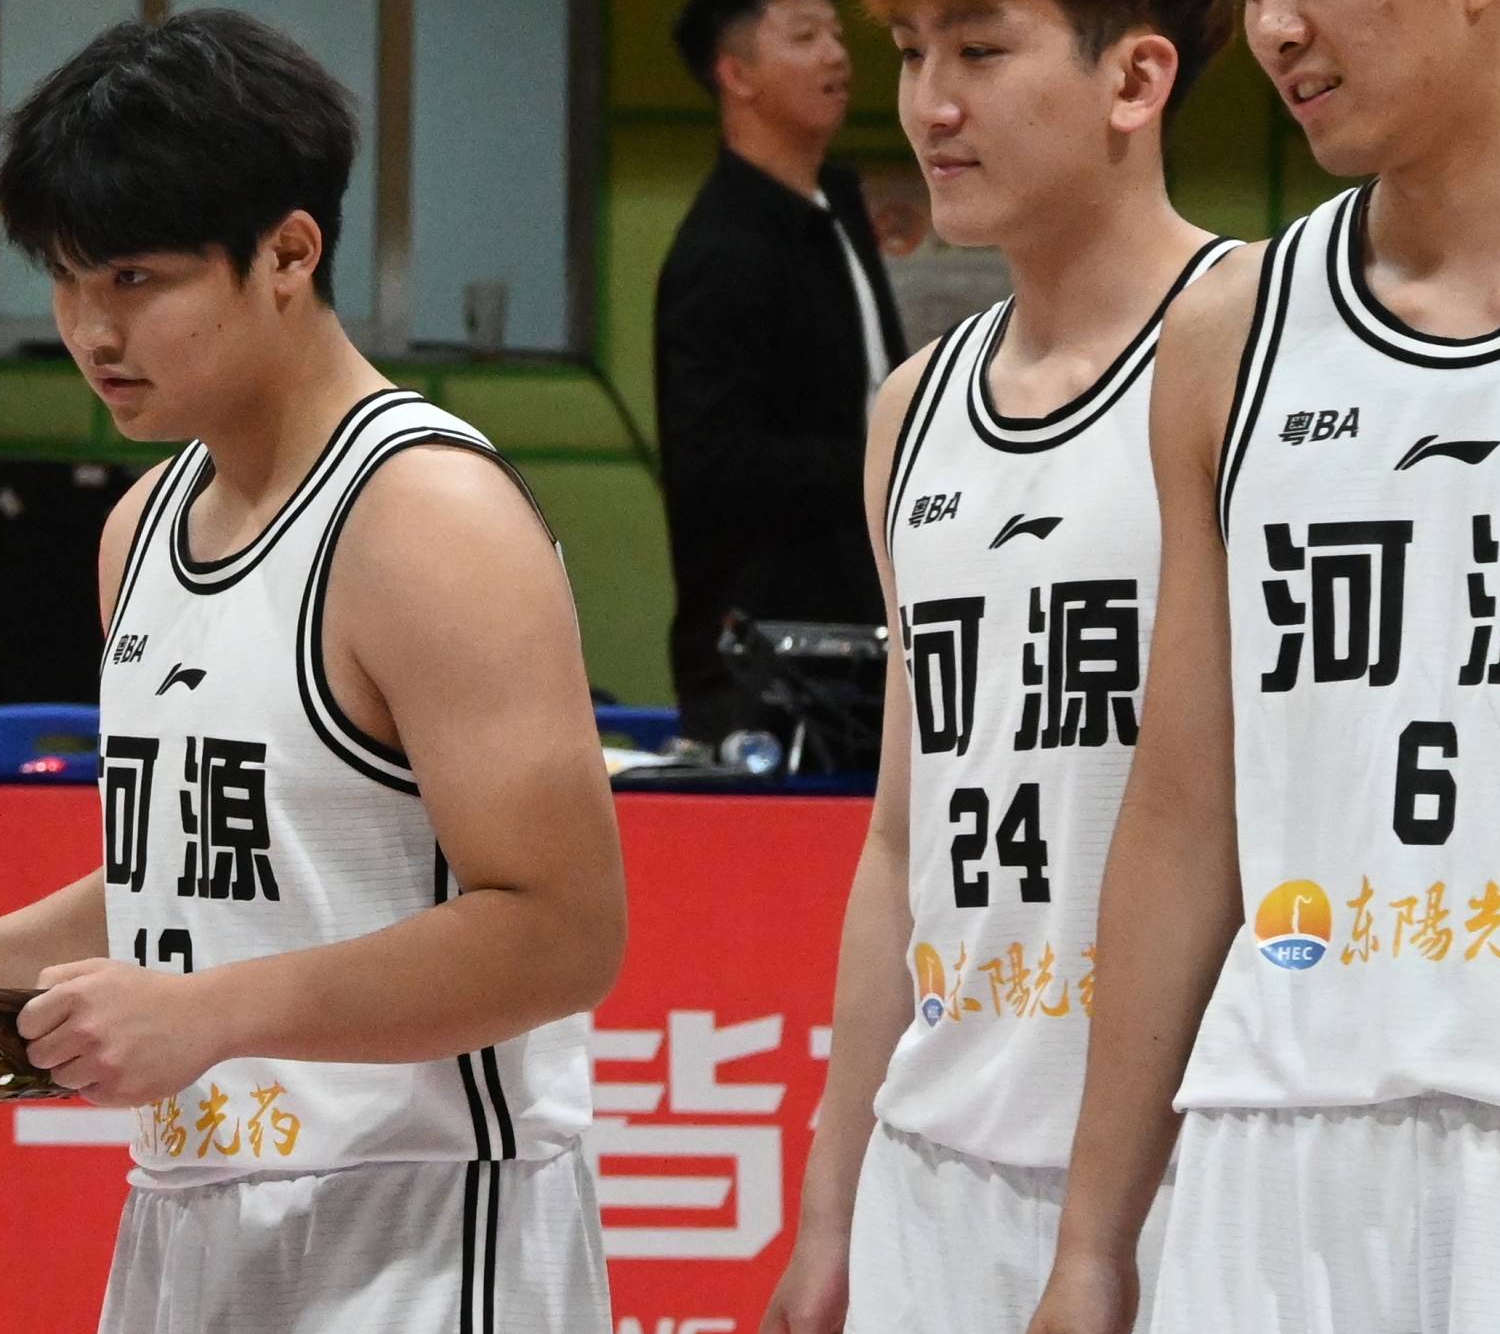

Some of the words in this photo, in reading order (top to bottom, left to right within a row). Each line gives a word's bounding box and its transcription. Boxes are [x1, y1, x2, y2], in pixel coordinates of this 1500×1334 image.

[1278, 405, 1361, 447] 粤BA
[908, 490, 962, 531] 粤BA
[900, 578, 1139, 757] 河源
[1392, 720, 1459, 846] 6
[949, 782, 1051, 909] 24
[1275, 944, 1314, 963] HEC
